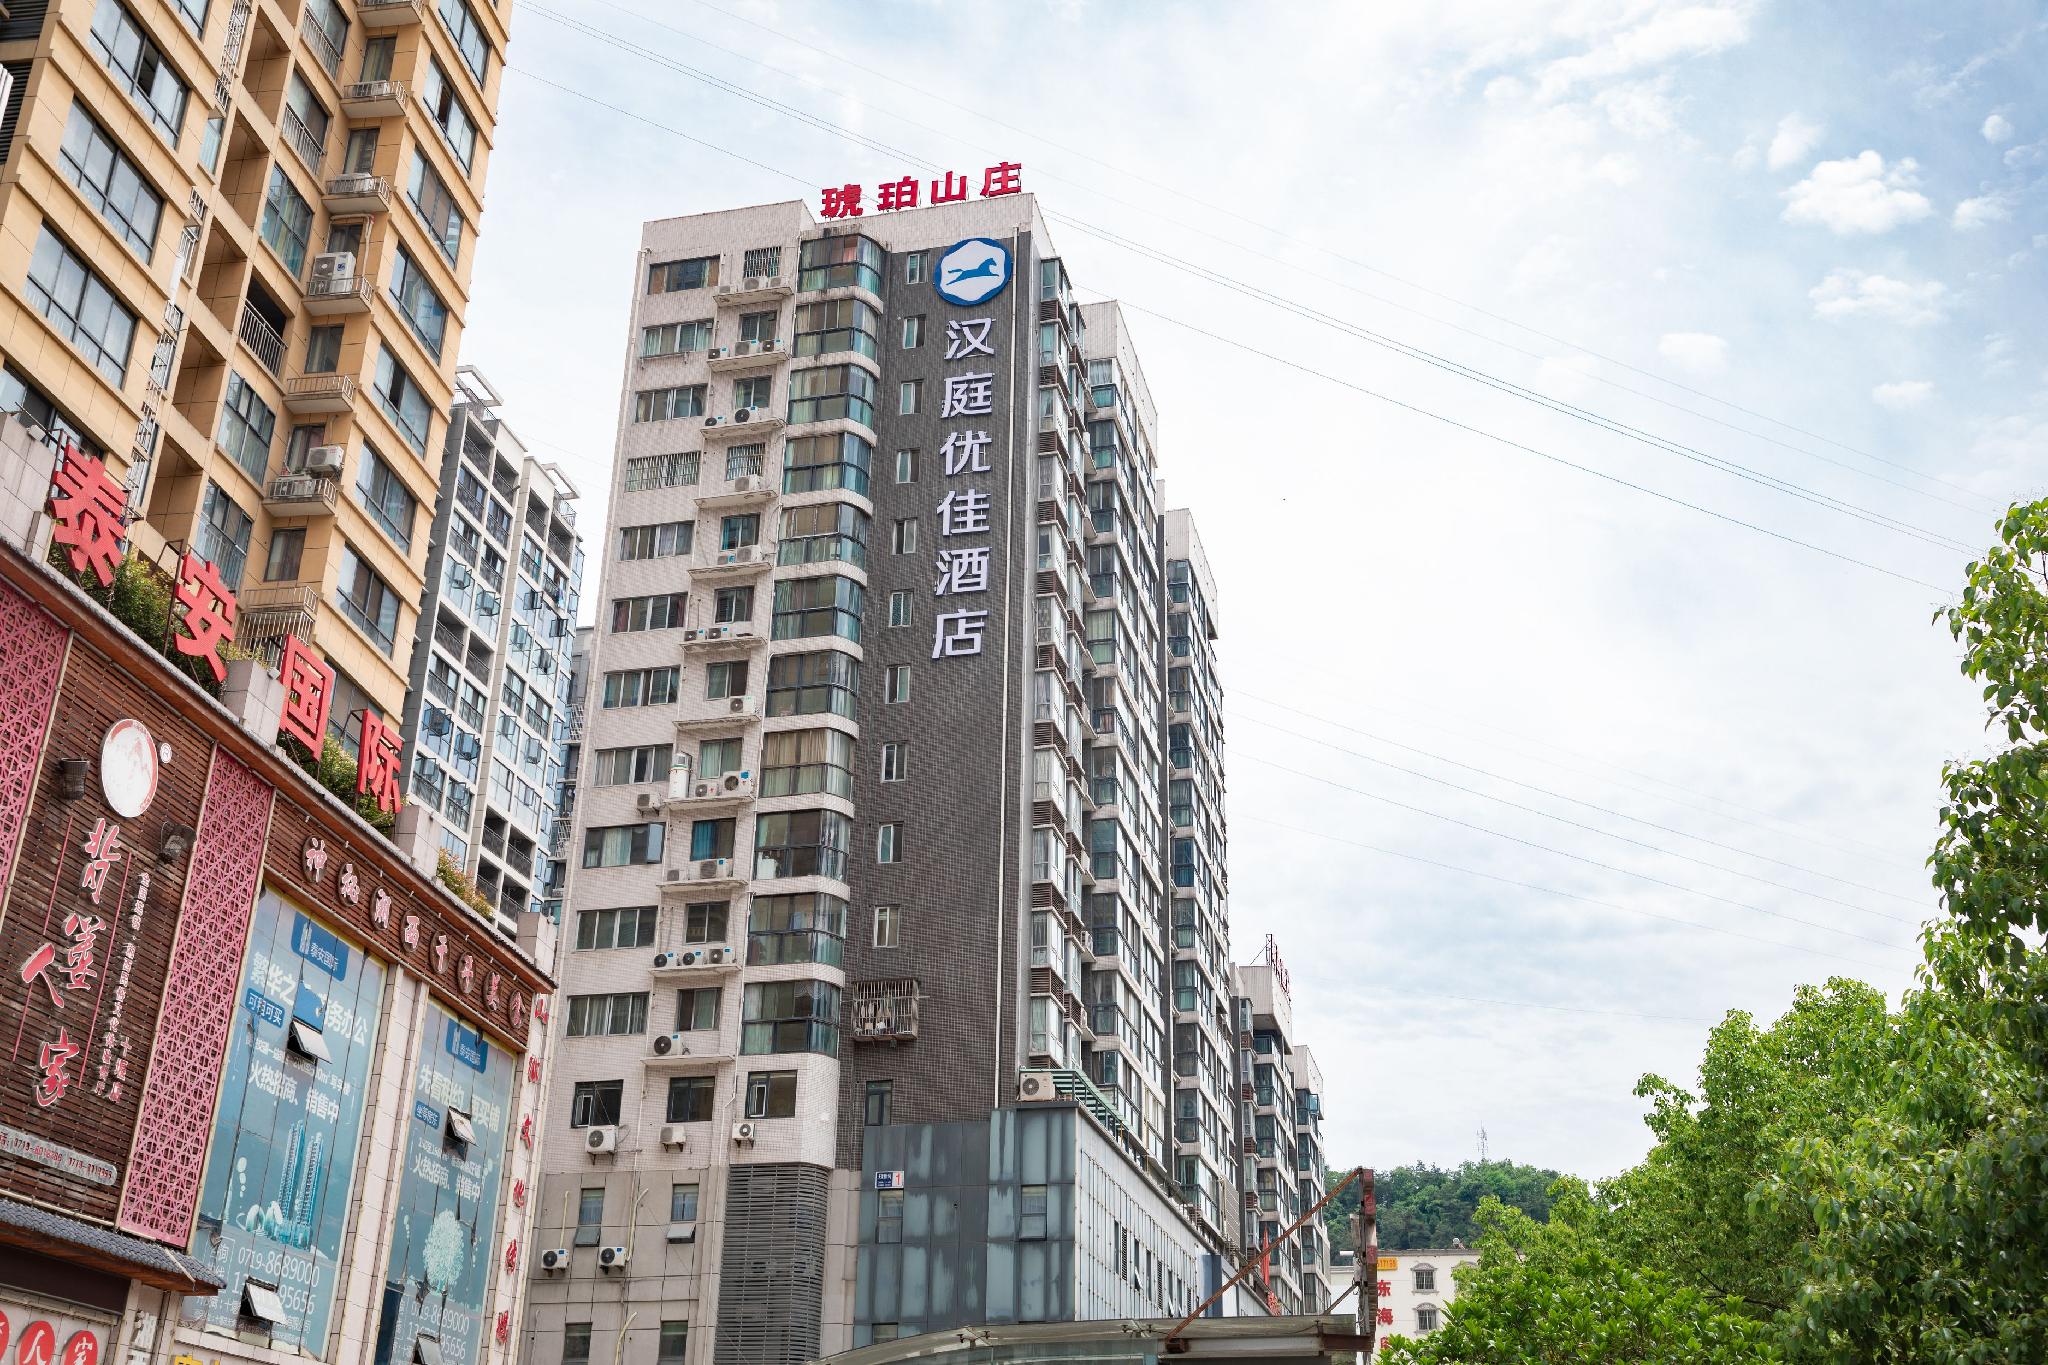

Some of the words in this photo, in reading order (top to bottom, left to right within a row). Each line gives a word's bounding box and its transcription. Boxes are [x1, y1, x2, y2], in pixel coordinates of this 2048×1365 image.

[821, 162, 1022, 218] 琥珀山庄
[932, 316, 996, 660] 汉庭优佳酒店
[50, 444, 404, 814] 泰安国际
[250, 952, 312, 1007] 繁华之
[310, 942, 340, 972] 泰安国际
[247, 992, 283, 1025] 可租可买
[238, 1247, 320, 1287] 0719-8689000
[0, 1320, 94, 1365] 人家
